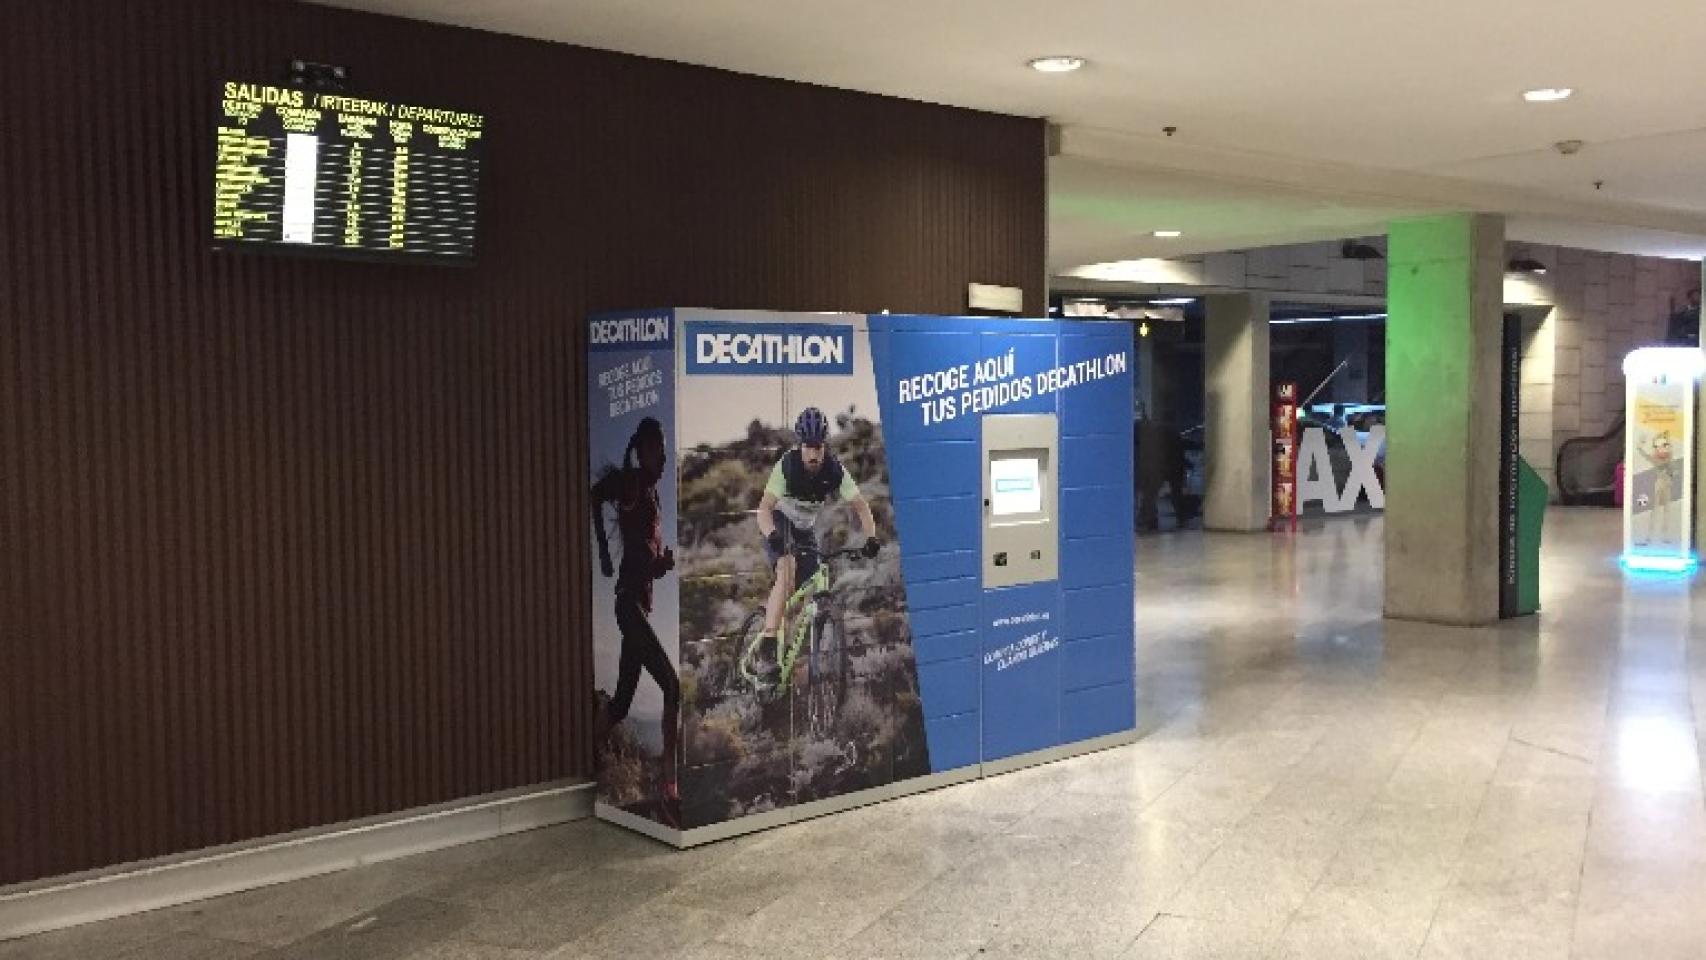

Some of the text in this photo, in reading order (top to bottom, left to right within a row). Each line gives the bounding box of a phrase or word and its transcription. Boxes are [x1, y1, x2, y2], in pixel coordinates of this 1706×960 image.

[225, 82, 304, 108] SALIDAS
[320, 95, 388, 116] IRTEERAK
[590, 316, 668, 344] DECATHLON
[696, 333, 843, 364] DECATHLON
[900, 347, 1015, 403] RECOGE AQUÍ
[921, 351, 1127, 426] TUS PEDIDOS DECATHLON
